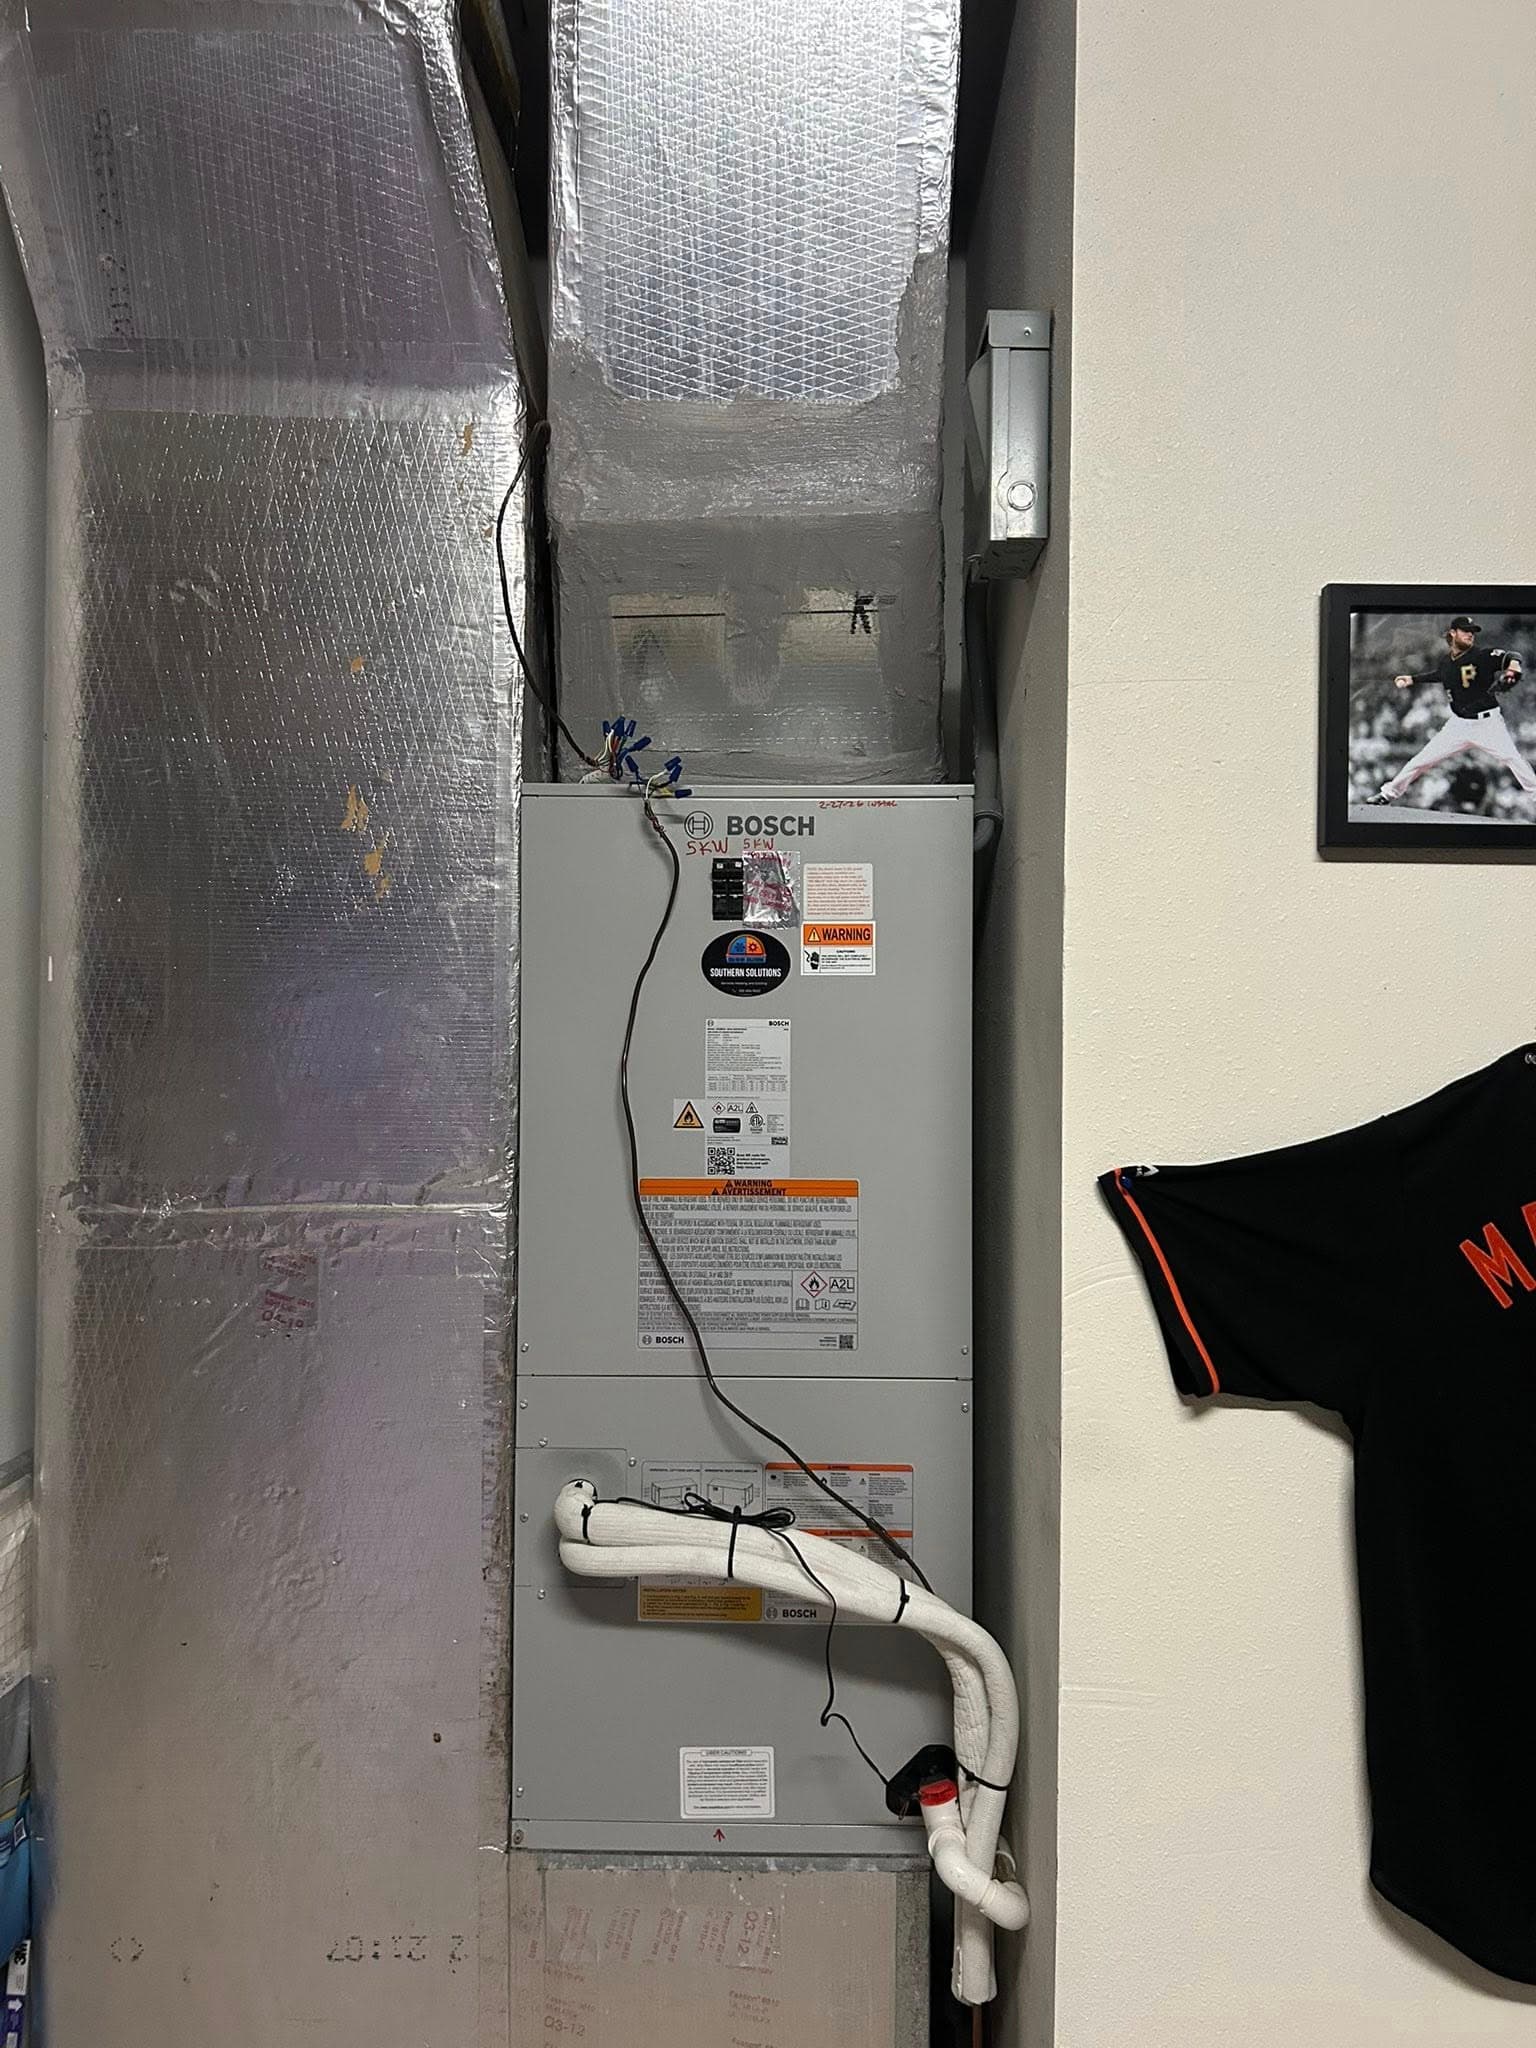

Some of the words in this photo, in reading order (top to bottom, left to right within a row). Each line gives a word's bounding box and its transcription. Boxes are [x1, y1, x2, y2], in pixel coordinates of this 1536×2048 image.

[727, 815, 815, 836] BOSCH
[822, 927, 871, 941] WARNING
[710, 967, 745, 978] SOUTHERN
[745, 967, 782, 978] SOLUTIONS
[728, 1104, 743, 1112] A2L
[734, 1180, 772, 1188] WARNING
[722, 1187, 786, 1196] AVERTISSEMENT
[831, 1279, 853, 1289] A2L
[655, 1336, 684, 1344] BOSCH
[783, 1609, 816, 1618] BOSCH
[544, 2015, 586, 2037] Q3-12
